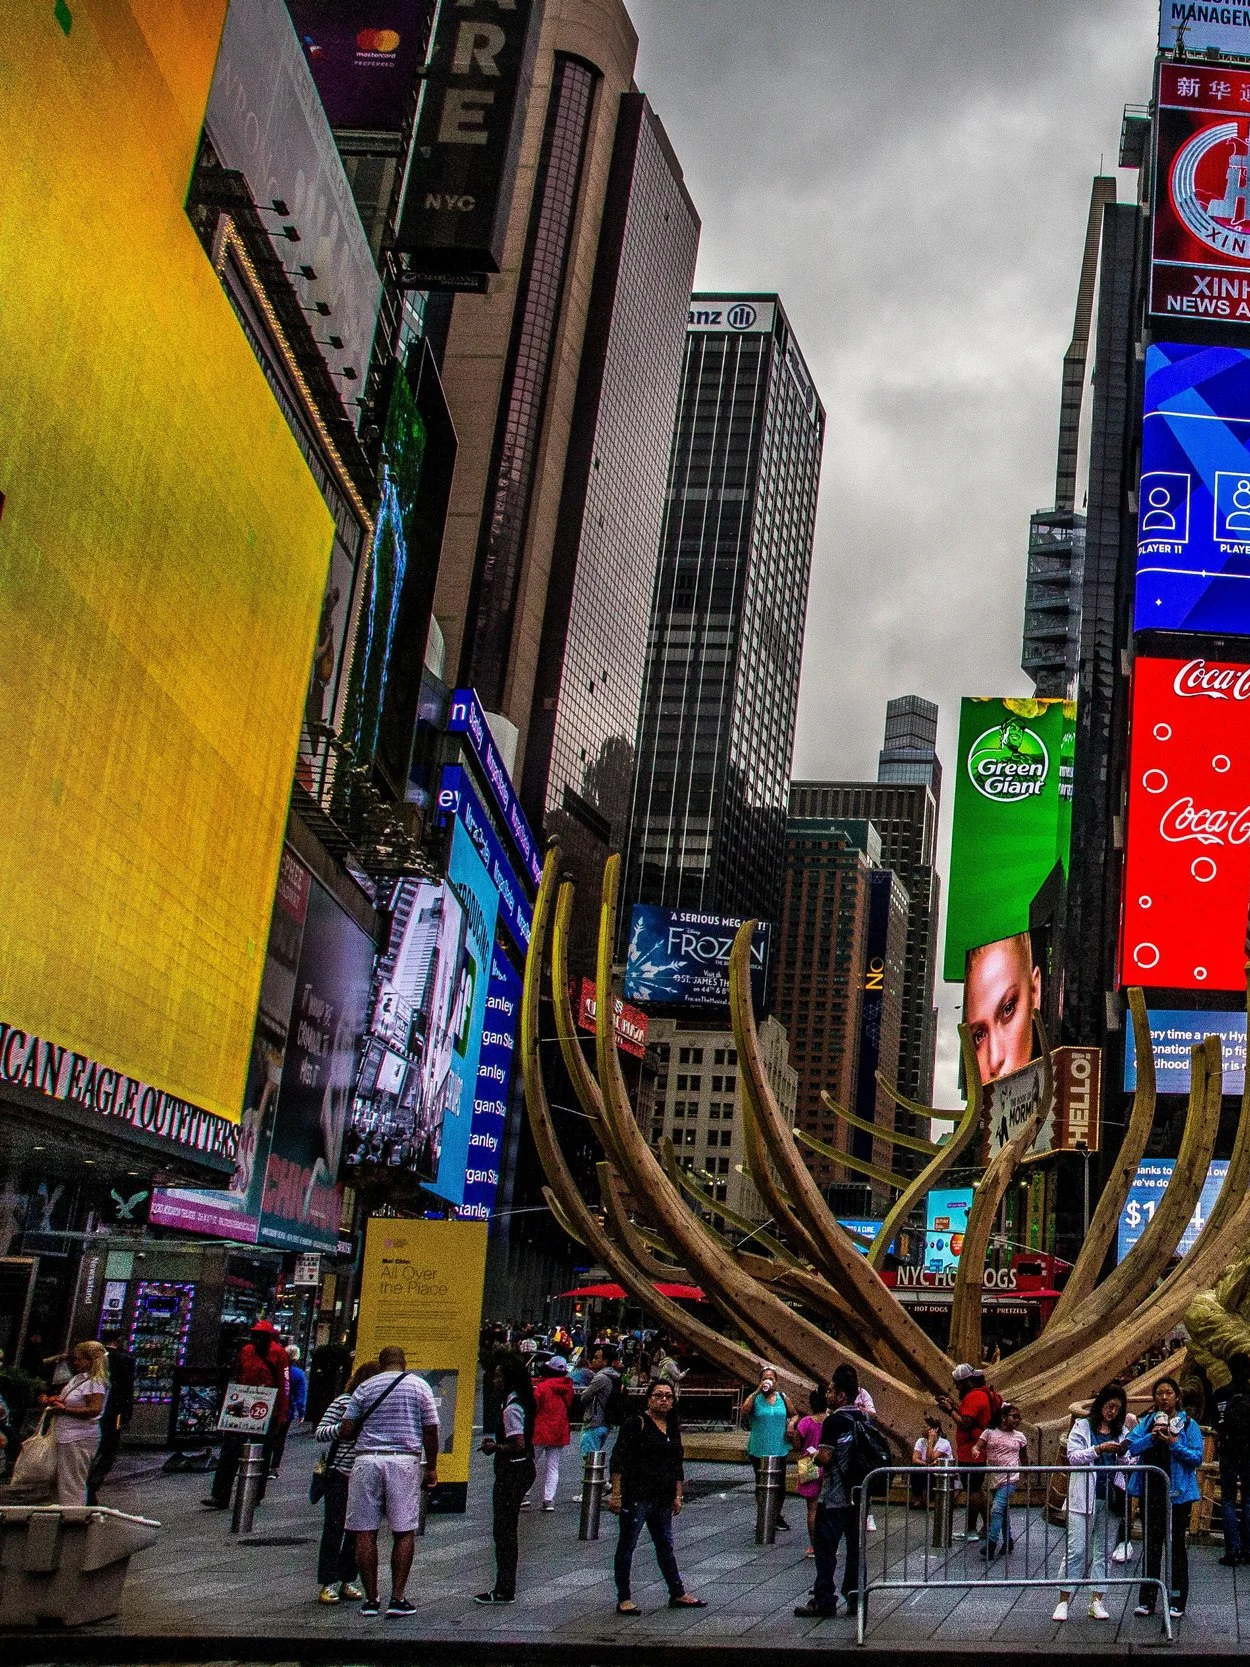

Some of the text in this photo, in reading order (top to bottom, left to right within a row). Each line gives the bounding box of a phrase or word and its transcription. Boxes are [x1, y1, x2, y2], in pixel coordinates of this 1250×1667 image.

[356, 51, 396, 59] mastercard
[425, 193, 476, 212] NYC
[1167, 295, 1231, 316] NEWS
[1138, 544, 1183, 556] PLAYER 11
[978, 759, 1043, 775] Green
[984, 777, 1044, 794] Giant
[680, 913, 720, 926] SERIOUS
[667, 927, 765, 964] FROZN
[693, 977, 717, 986] JAMES
[1149, 1031, 1165, 1042] ery
[1167, 1029, 1192, 1040] time
[1152, 1045, 1191, 1054] onation
[1231, 1062, 1239, 1070] is
[70, 1051, 138, 1120] EAGLE
[141, 1086, 241, 1161] OUTFITTERS
[1068, 1052, 1092, 1147] HELLO!
[381, 1266, 437, 1281] All Over
[897, 1266, 929, 1286] NYC
[983, 1267, 1017, 1288] OGS
[380, 1281, 448, 1296] the Place
